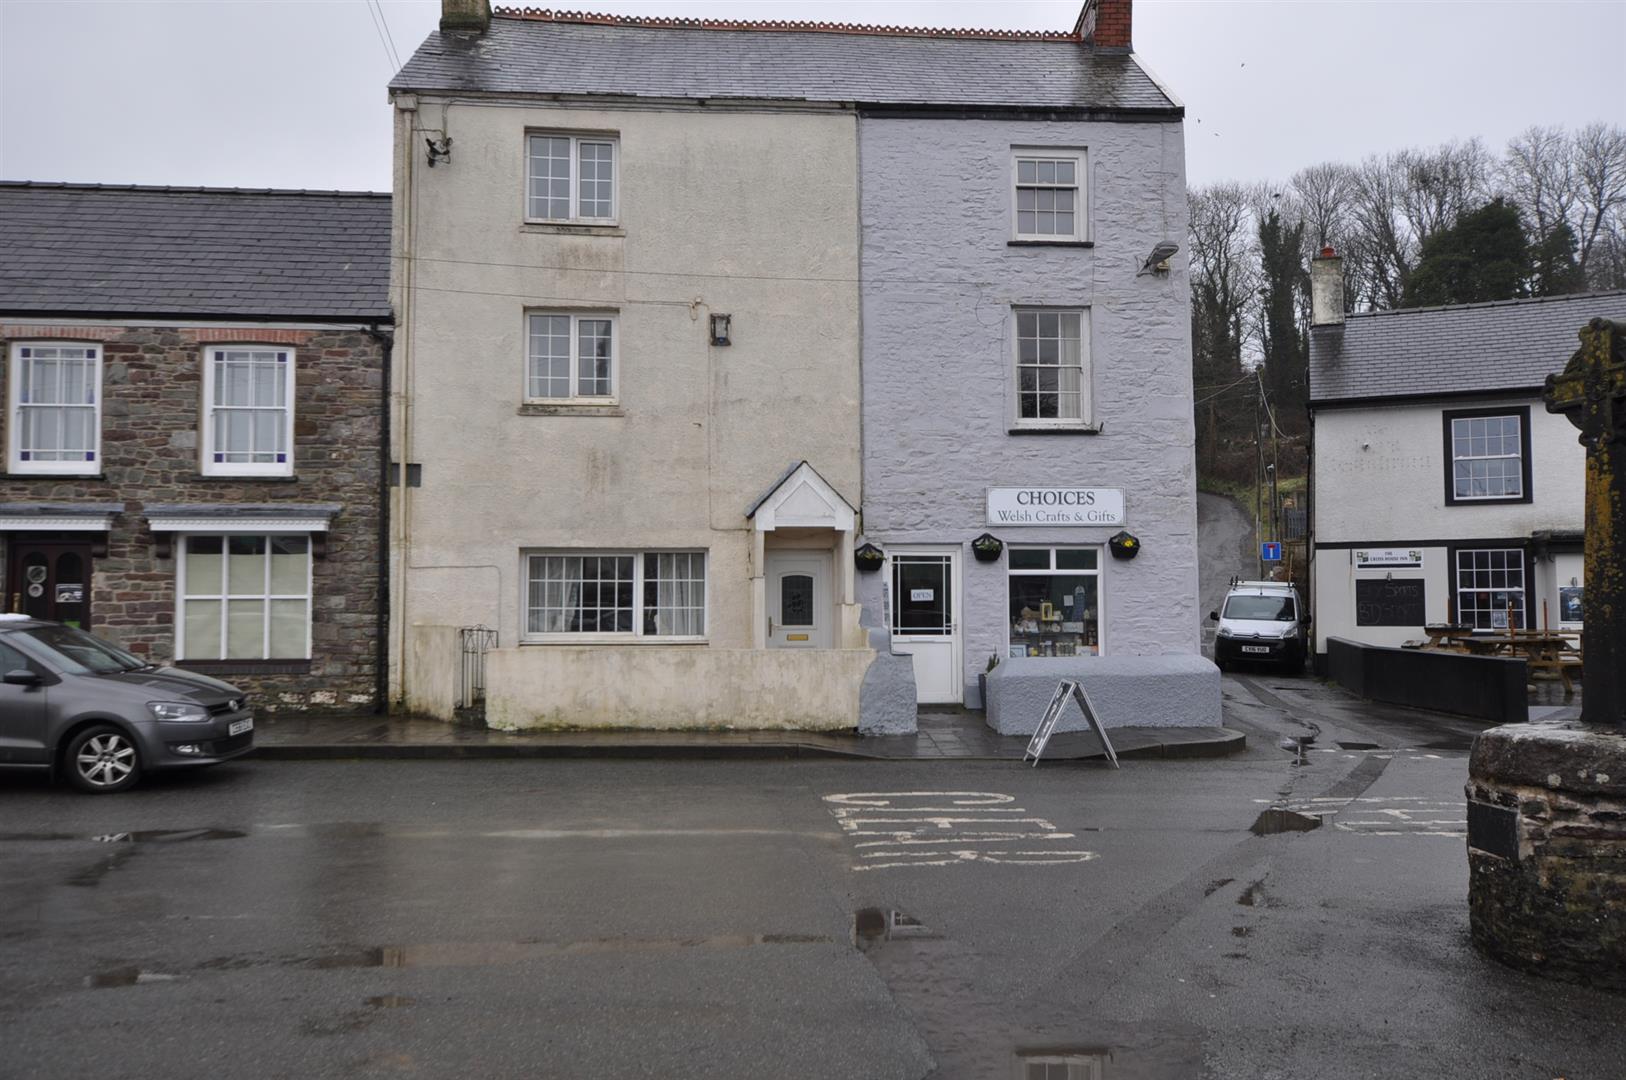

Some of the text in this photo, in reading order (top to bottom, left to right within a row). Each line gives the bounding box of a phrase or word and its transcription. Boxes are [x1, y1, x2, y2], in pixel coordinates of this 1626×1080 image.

[1016, 491, 1095, 505] CHOICES
[997, 510, 1116, 521] Welsh Crafts & Gifts
[912, 591, 932, 600] OPEN
[822, 791, 1101, 871] CLEAR
